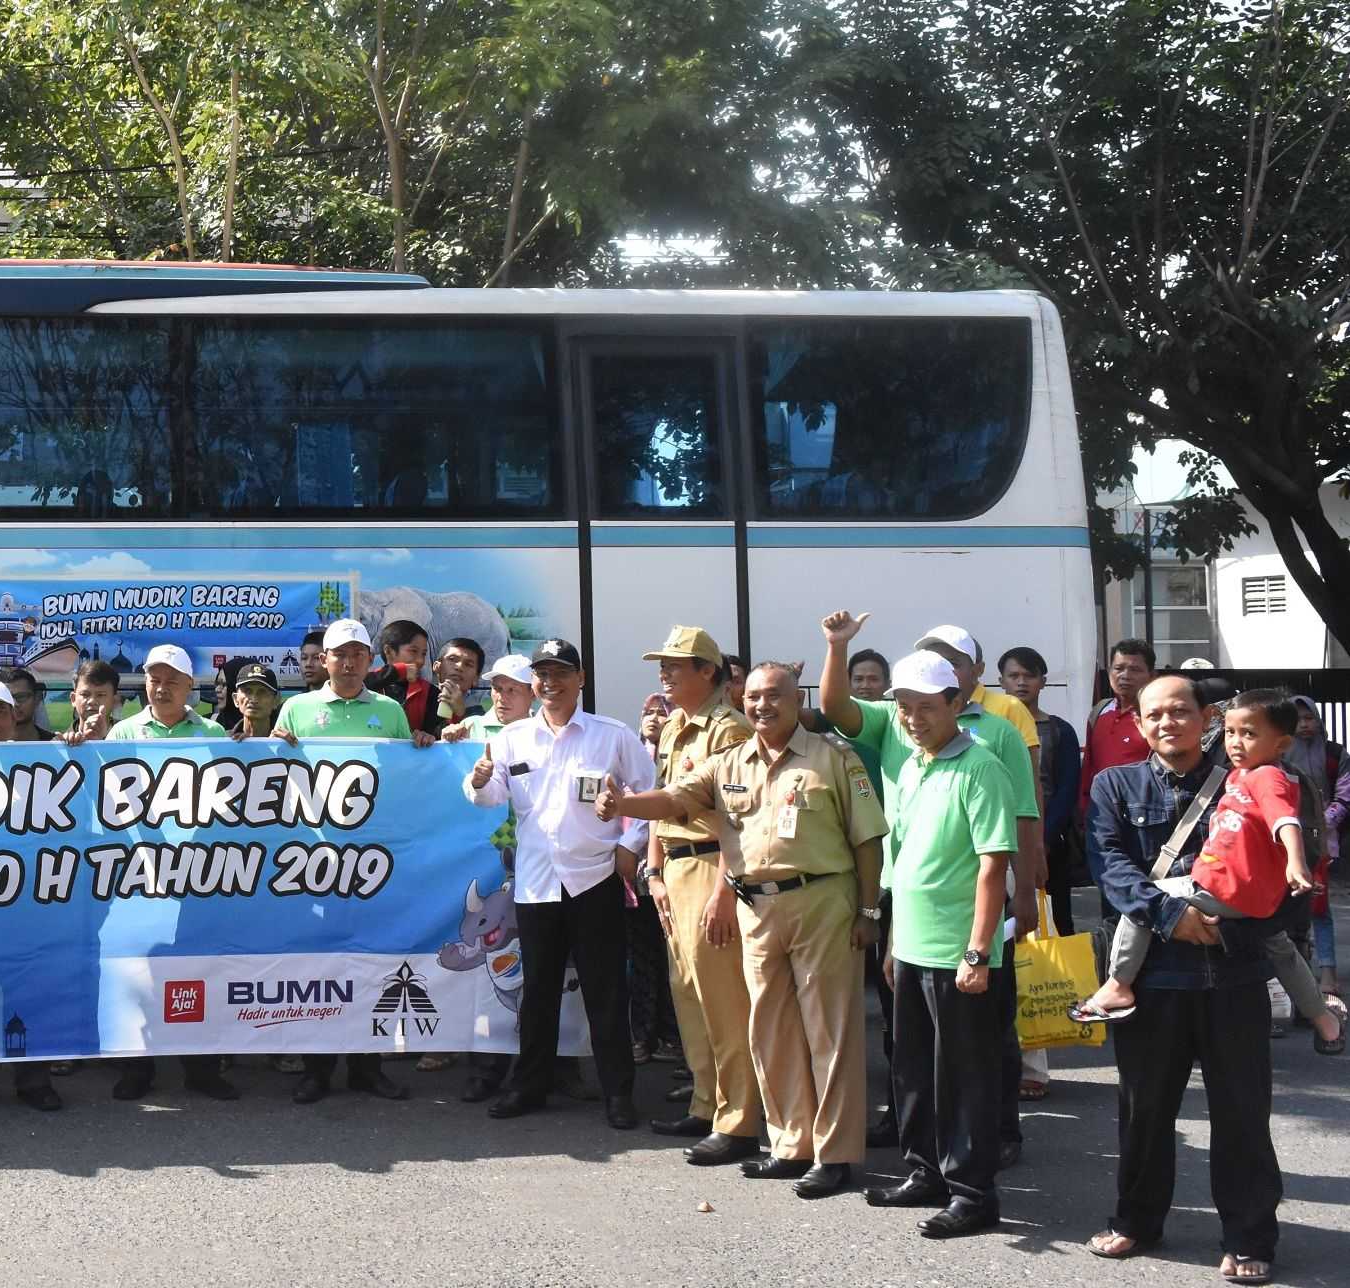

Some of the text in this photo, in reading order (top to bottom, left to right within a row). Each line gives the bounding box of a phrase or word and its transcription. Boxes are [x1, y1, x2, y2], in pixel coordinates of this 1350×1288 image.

[43, 585, 280, 617] BUMN MUDIK BARENG
[40, 611, 285, 640] IDUL FITRI 1440 H TAHUN 2019
[98, 757, 379, 831] BARENG
[33, 847, 80, 903] H
[84, 842, 265, 901] TAHUN
[270, 842, 394, 900] 2019
[171, 998, 195, 1012] Aja!
[172, 987, 198, 999] Link
[227, 980, 353, 1005] BUMN
[237, 1004, 343, 1021] Hadir untuk negeri
[371, 1017, 442, 1037] KIW
